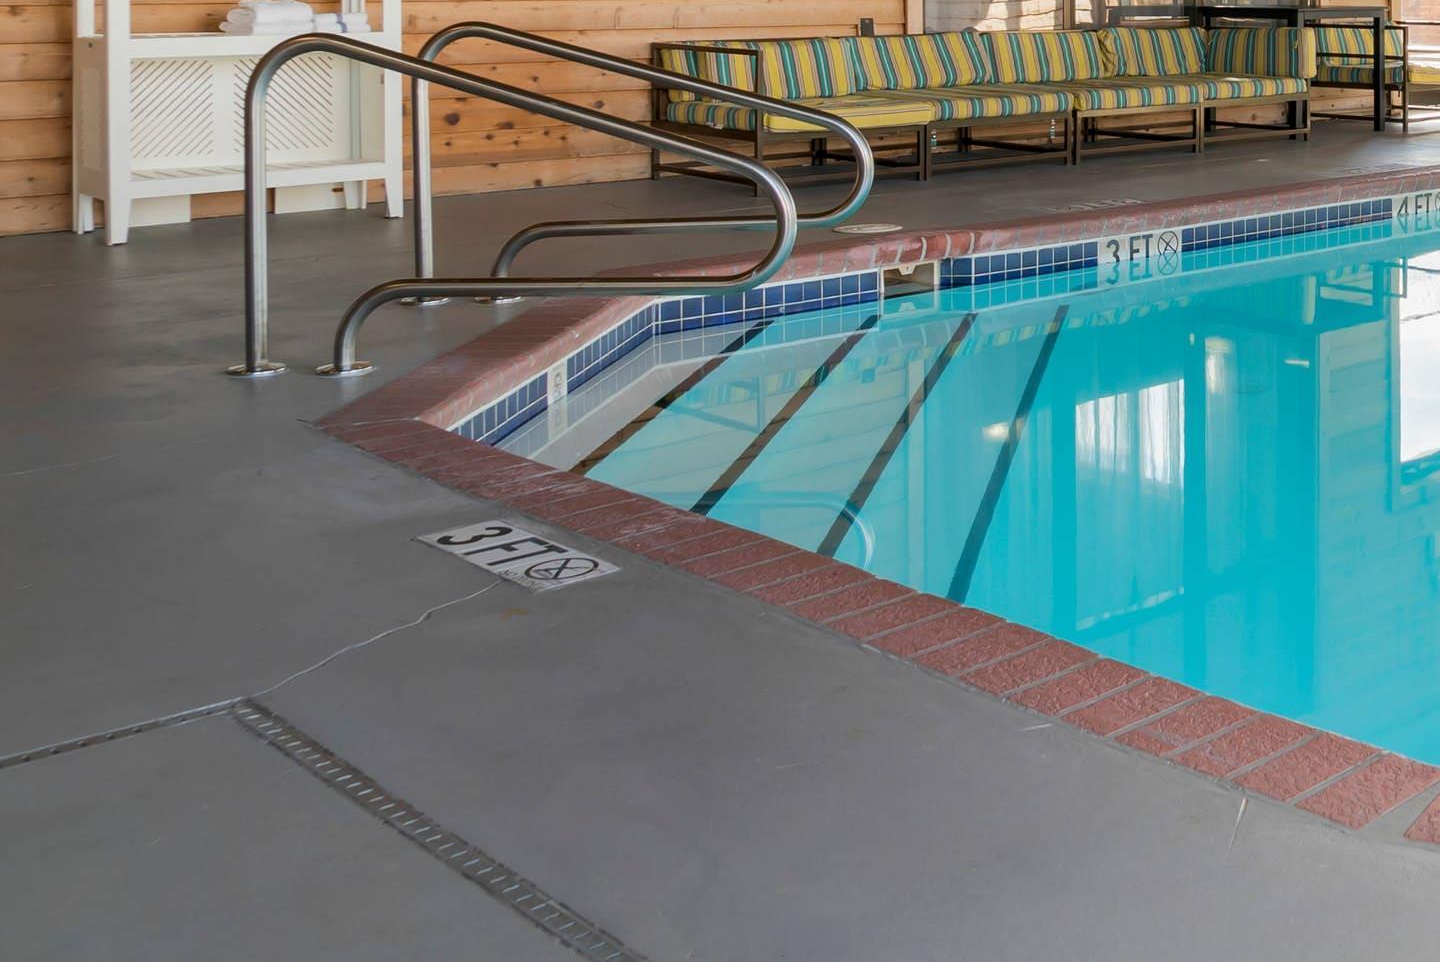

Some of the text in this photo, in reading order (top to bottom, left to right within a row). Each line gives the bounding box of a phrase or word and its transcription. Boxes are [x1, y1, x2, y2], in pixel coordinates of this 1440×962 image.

[1396, 192, 1433, 216] 4 FT
[1106, 234, 1154, 263] 3 FT
[437, 526, 569, 566] 3 FT
